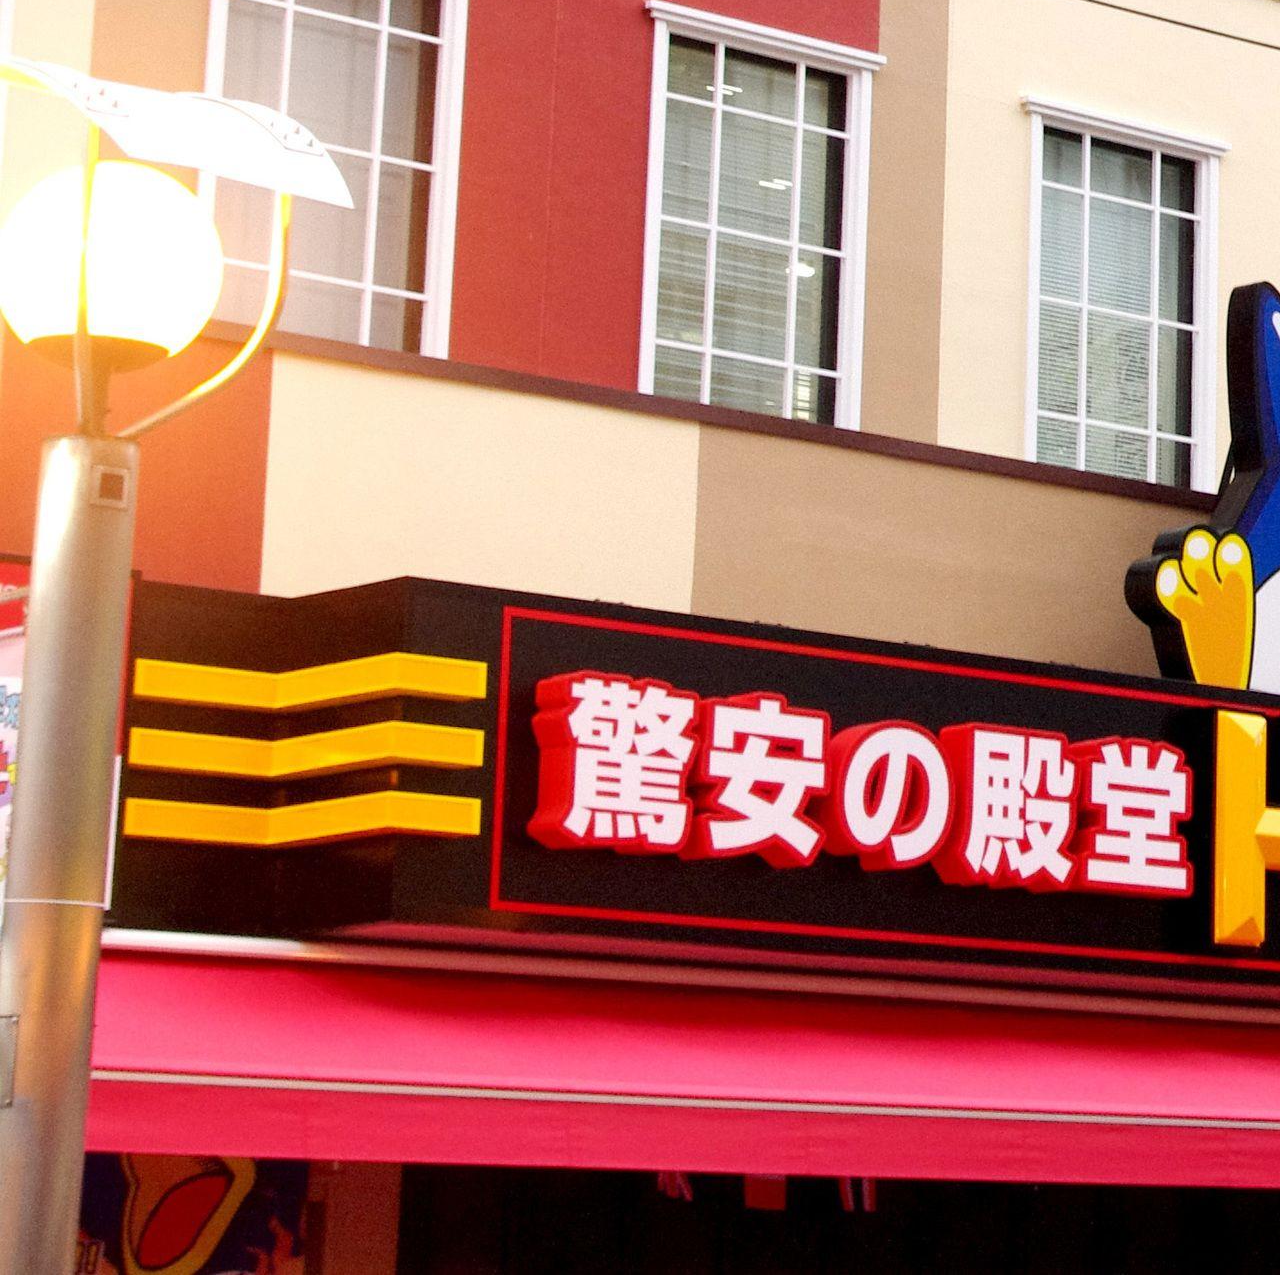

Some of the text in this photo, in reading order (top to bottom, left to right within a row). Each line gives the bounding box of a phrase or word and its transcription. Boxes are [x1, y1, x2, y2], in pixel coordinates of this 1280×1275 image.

[561, 676, 1191, 893] 驚安の殿堂
